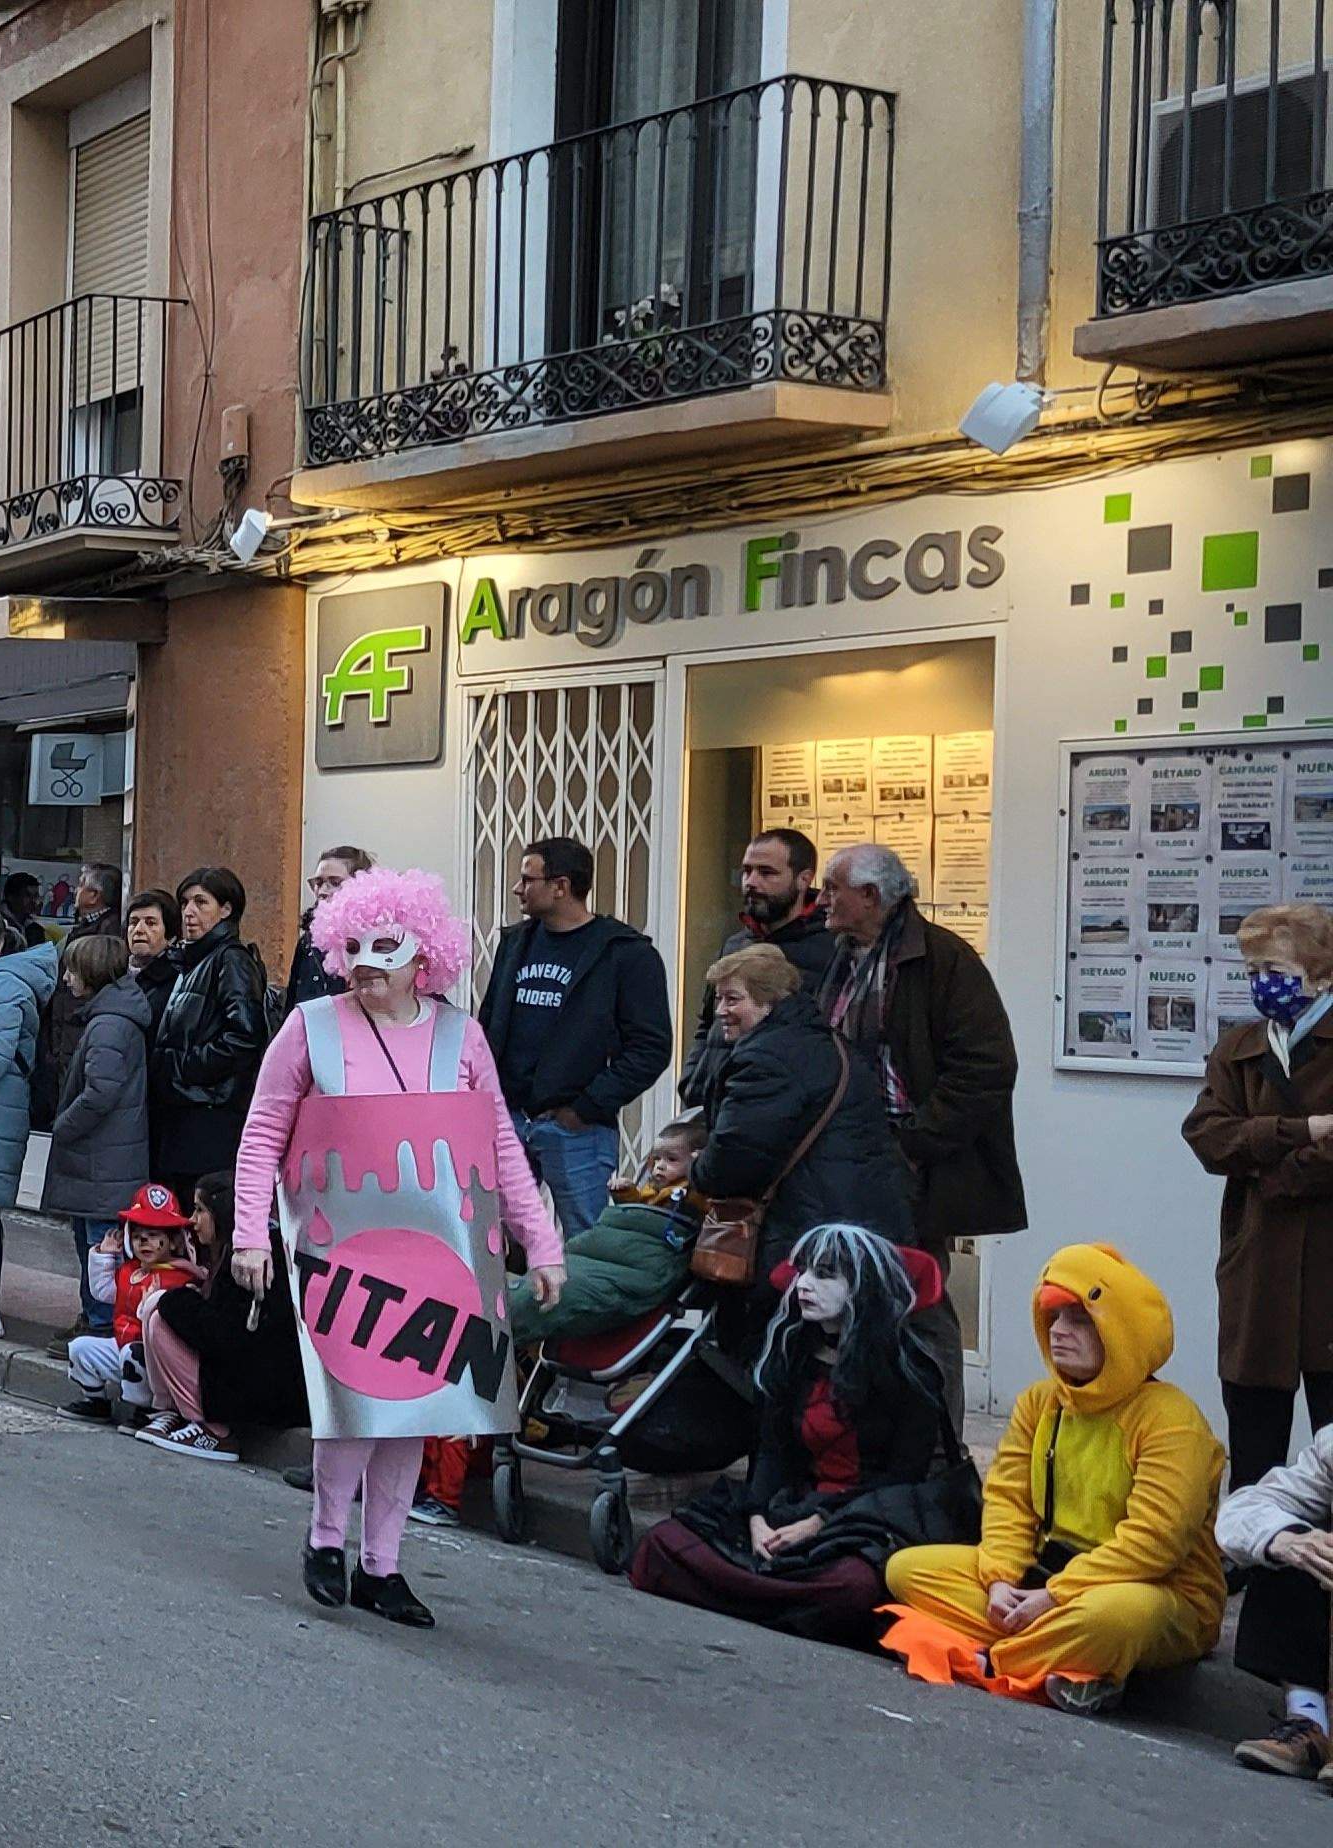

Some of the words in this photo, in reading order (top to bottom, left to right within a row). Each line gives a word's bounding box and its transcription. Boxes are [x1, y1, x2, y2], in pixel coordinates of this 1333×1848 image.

[461, 548, 711, 648] Aragón
[745, 524, 1005, 611] Fincas
[1219, 765, 1278, 776] CANFRANC
[1221, 867, 1270, 878] HUESCA
[1149, 971, 1197, 983] NUENO
[516, 987, 563, 1008] RIDERS
[293, 1250, 511, 1404] TITAN
